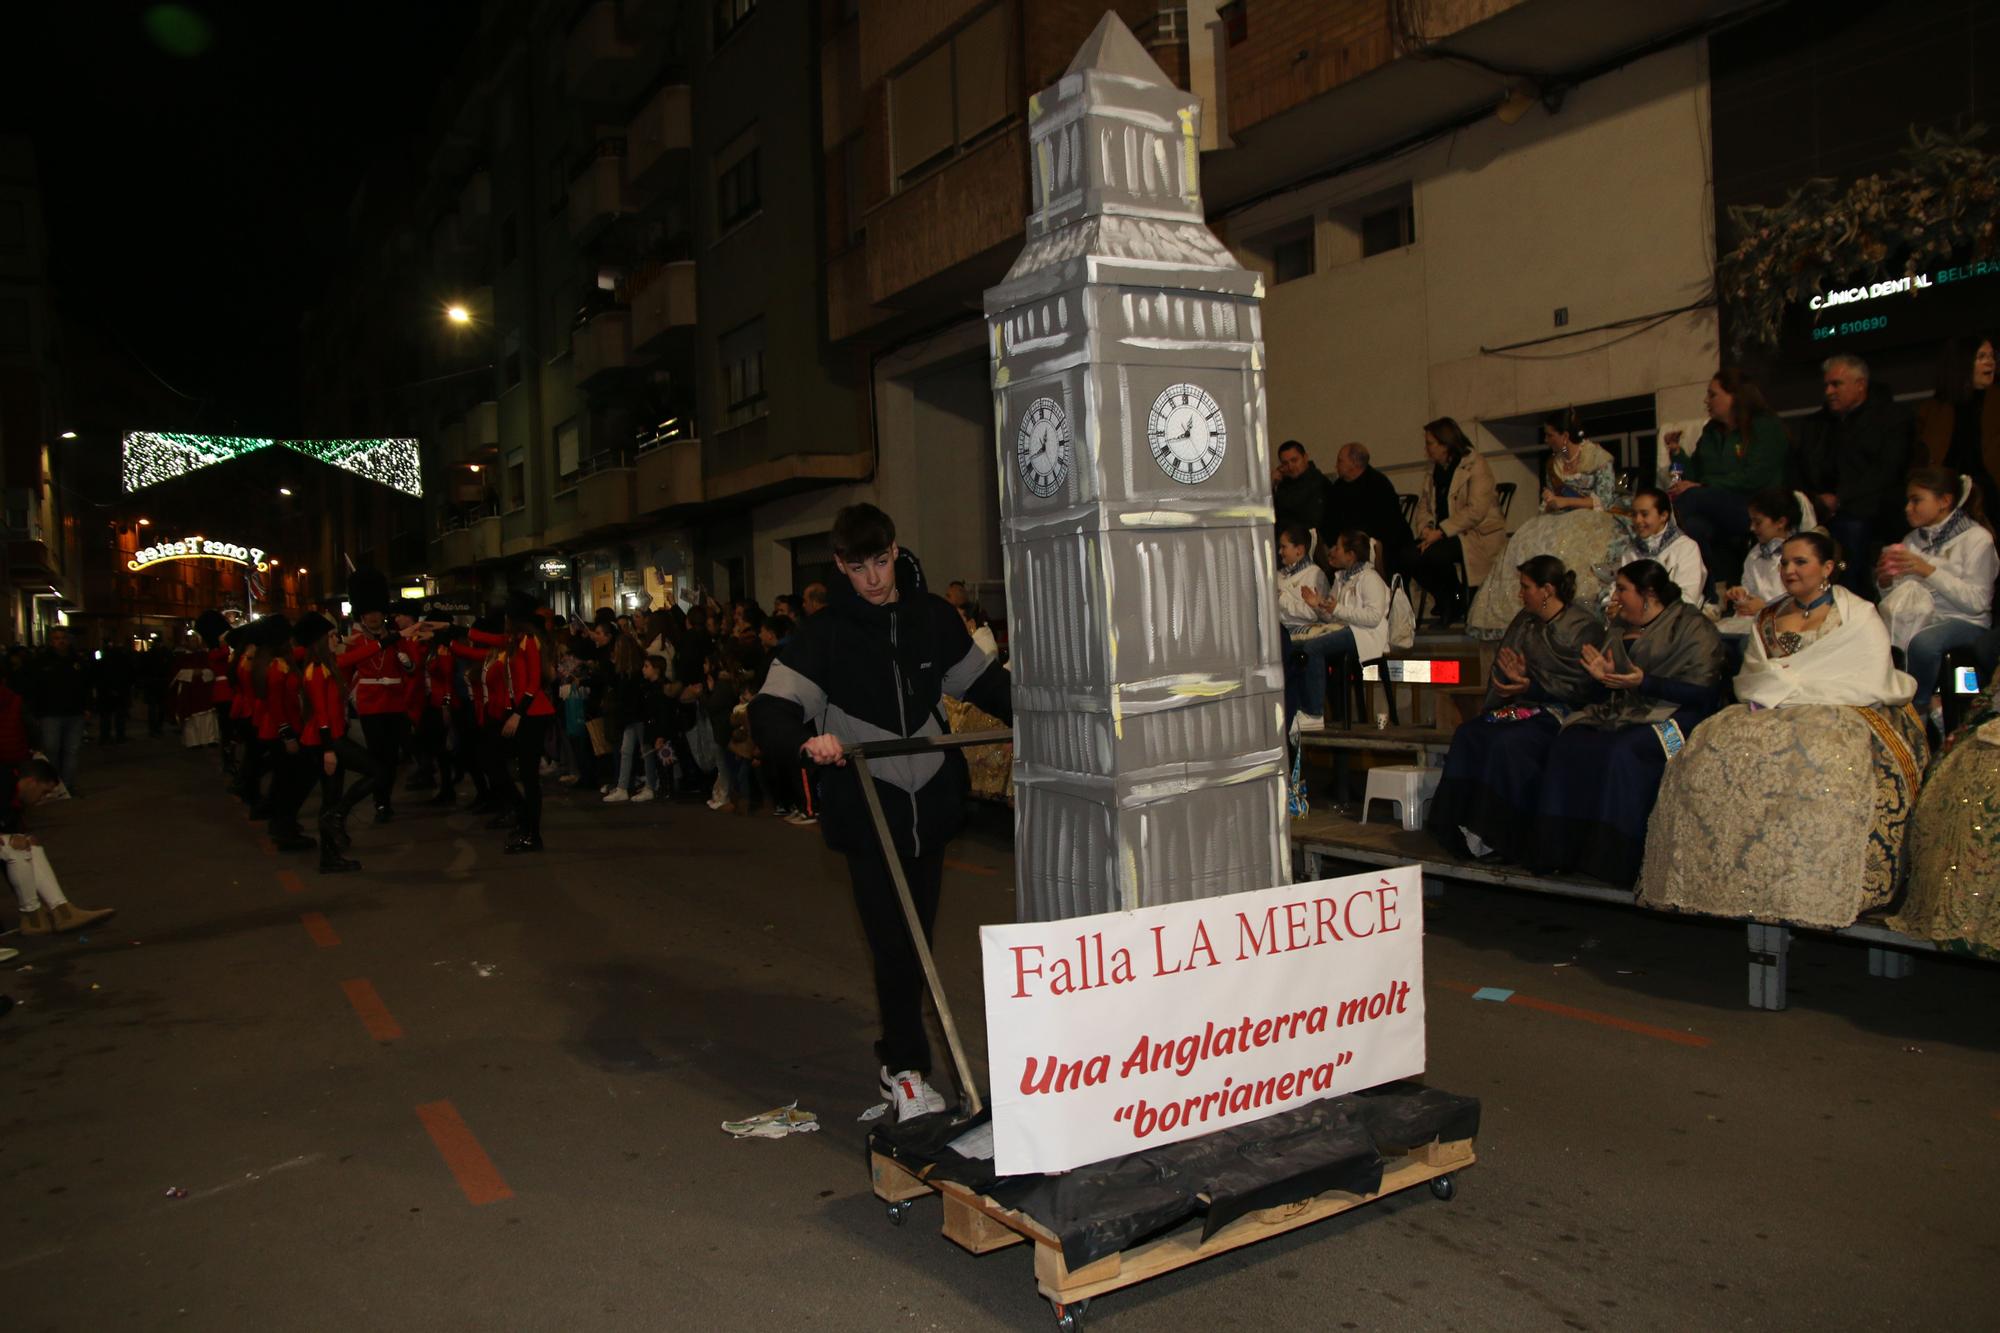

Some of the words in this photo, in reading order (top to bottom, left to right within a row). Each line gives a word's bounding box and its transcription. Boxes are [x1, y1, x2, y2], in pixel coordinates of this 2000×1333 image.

[1869, 273, 1933, 299] DENTAL
[1840, 315, 1888, 335] 510690
[1008, 931, 1136, 999] Falla
[1150, 919, 1221, 977] LA
[1235, 878, 1401, 961] MERCÈ
[1019, 1055, 1111, 1096] Una
[1119, 1006, 1328, 1080] Anglaterra
[1336, 980, 1411, 1029] molt
